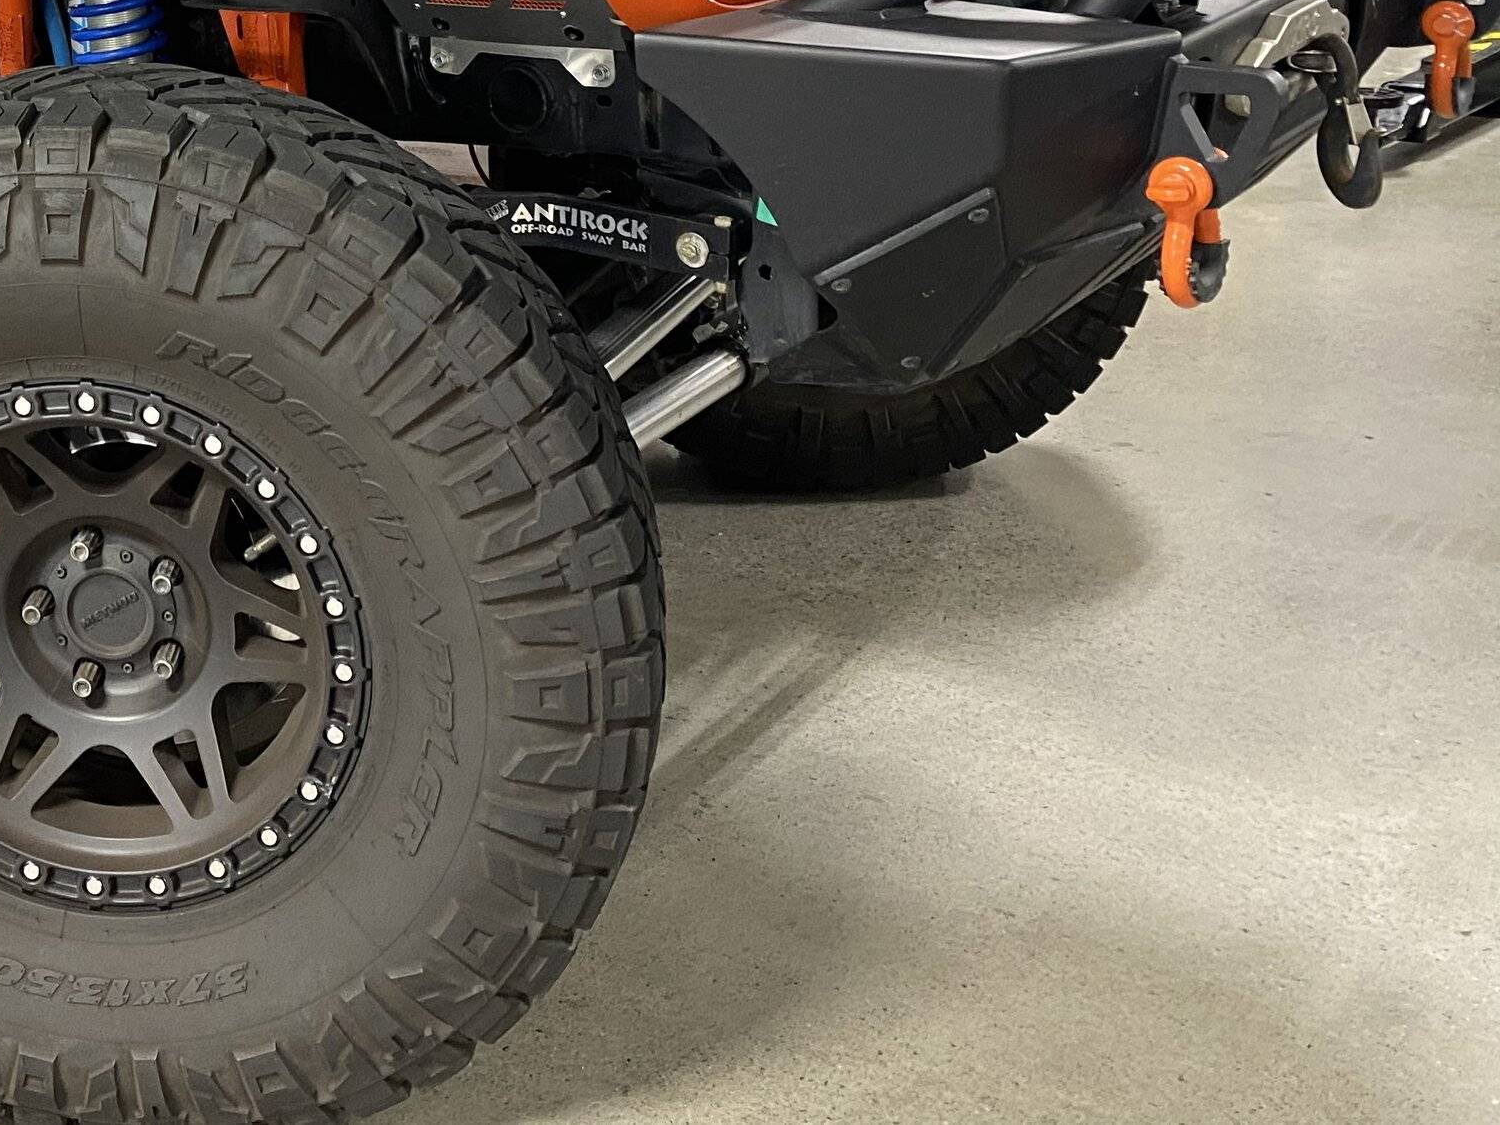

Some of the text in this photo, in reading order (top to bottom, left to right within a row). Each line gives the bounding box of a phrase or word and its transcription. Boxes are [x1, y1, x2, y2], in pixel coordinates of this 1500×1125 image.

[511, 202, 648, 241] ANTIROCK
[511, 224, 647, 253] OFF-ROAD SWAY BAR
